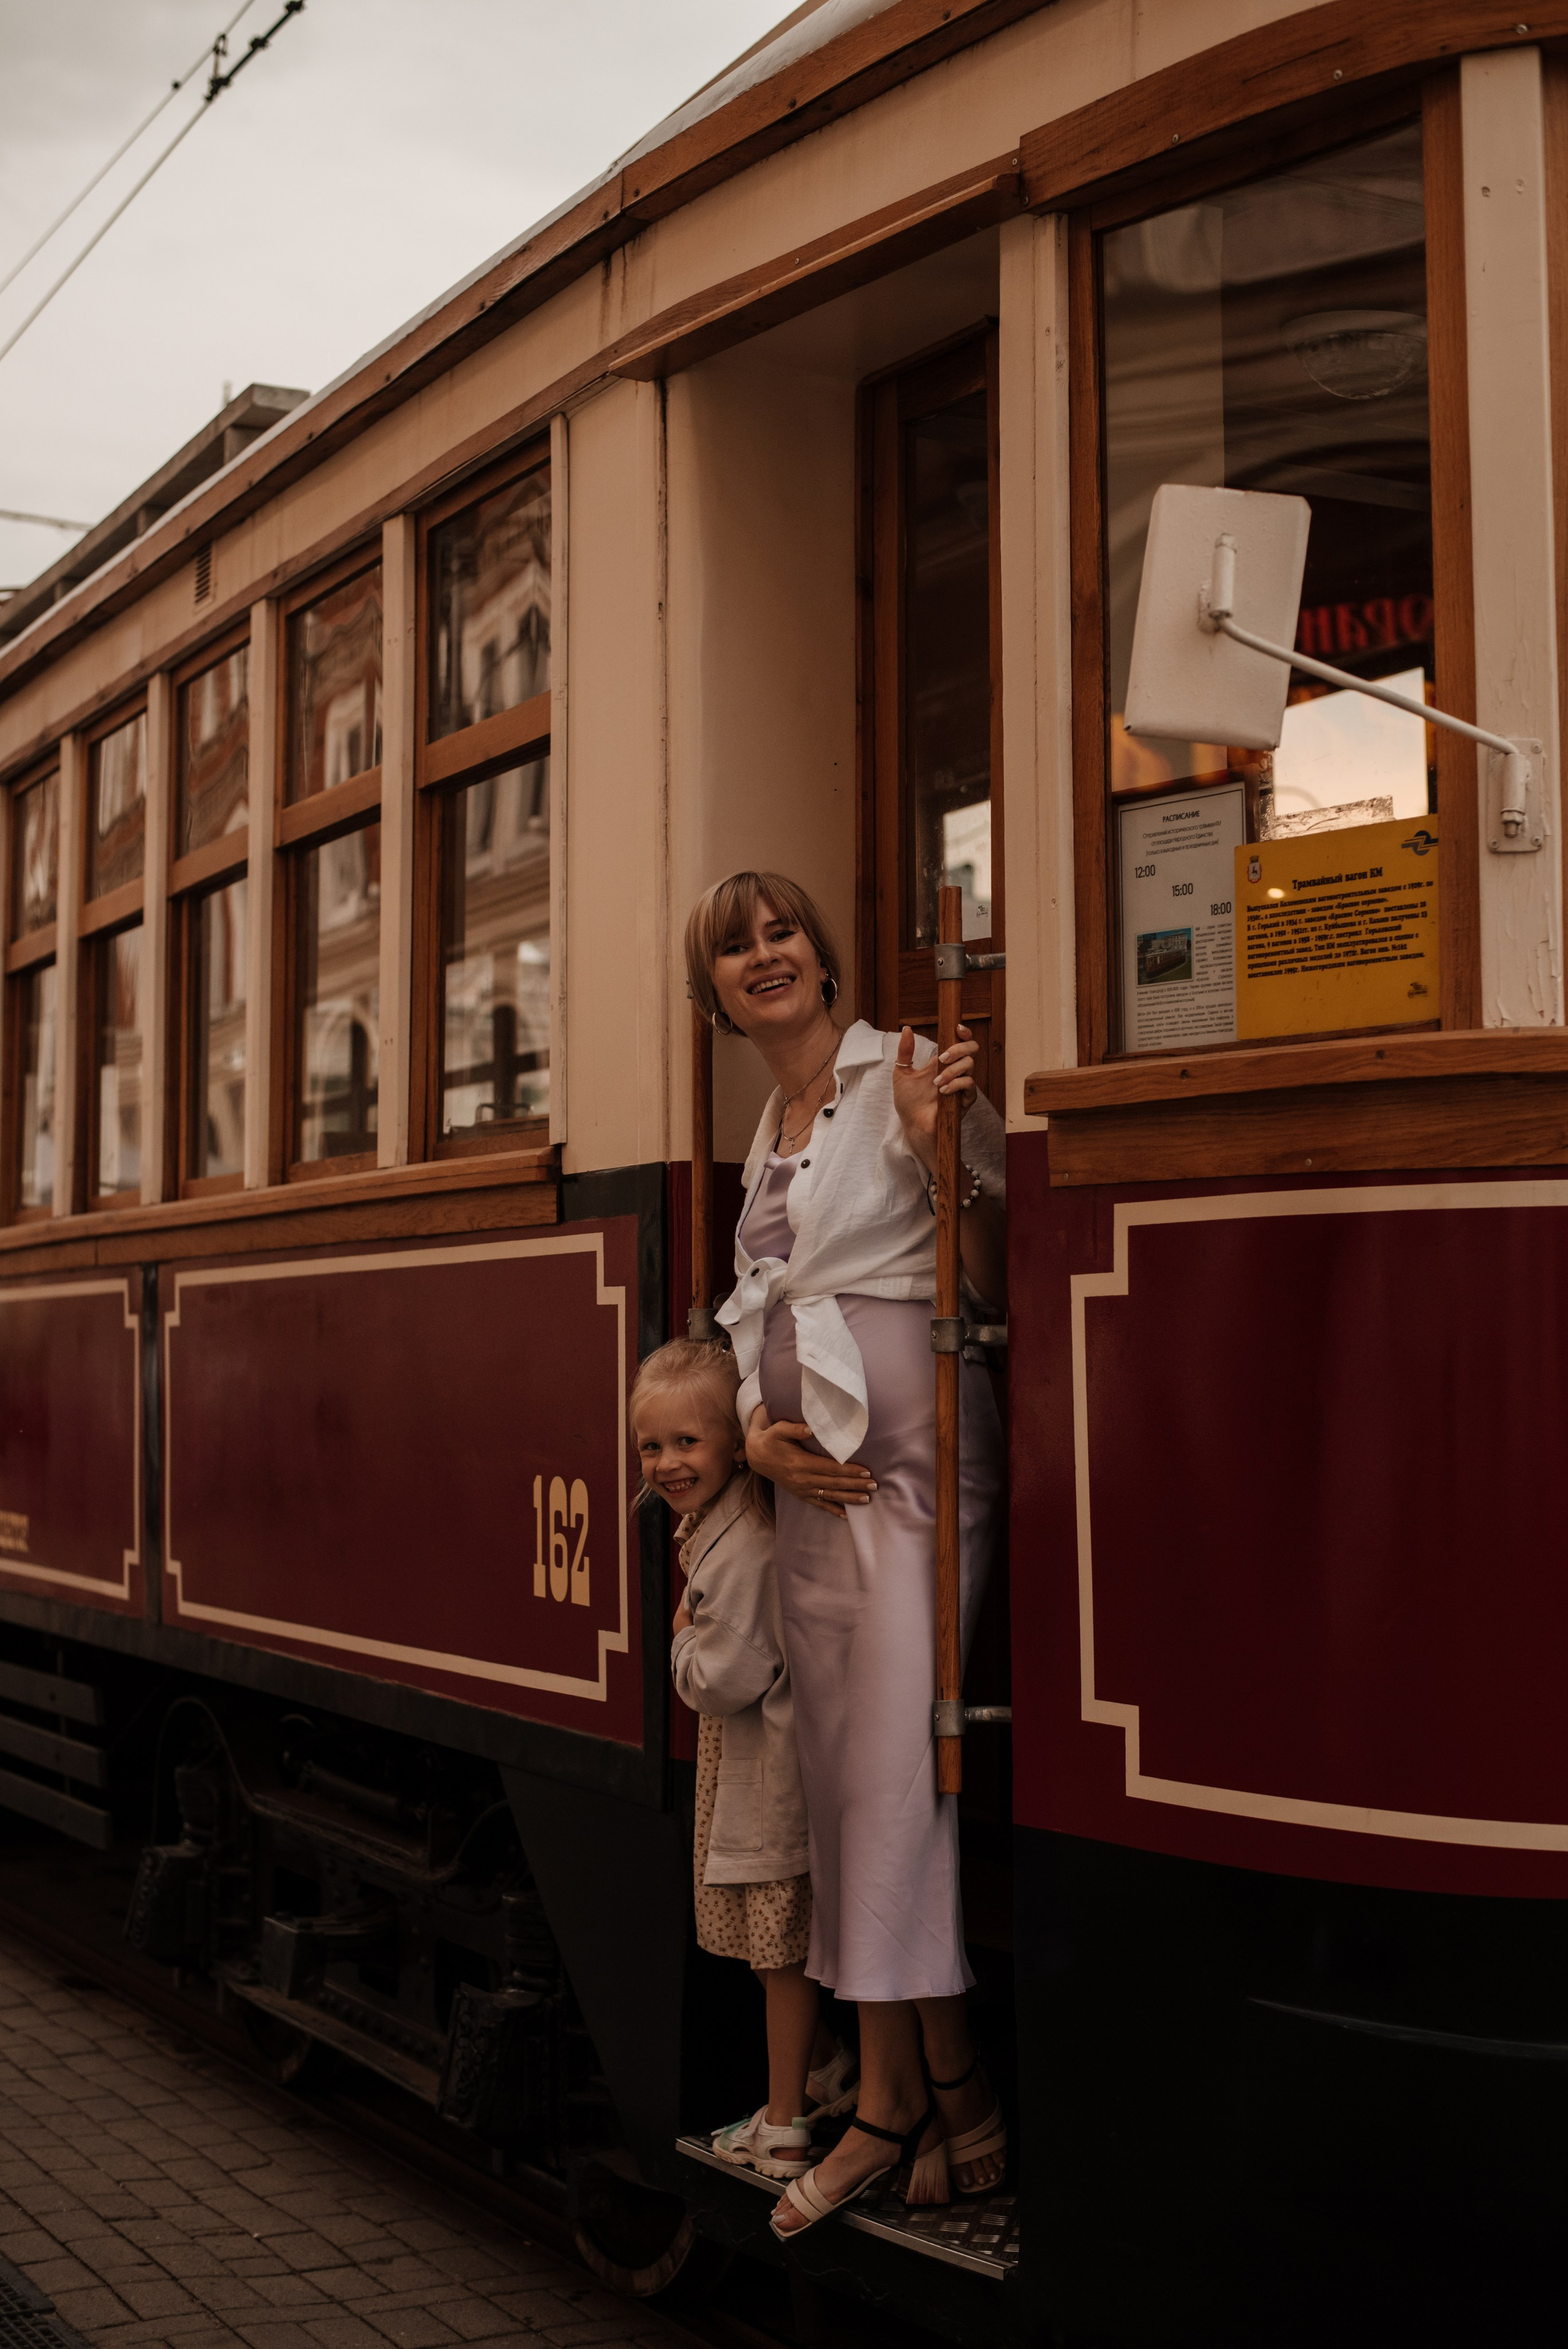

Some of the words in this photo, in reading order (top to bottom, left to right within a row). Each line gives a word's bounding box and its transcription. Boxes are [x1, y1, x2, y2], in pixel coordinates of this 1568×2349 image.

[1163, 810, 1200, 823] РАСПИСАНИЕ
[1135, 864, 1156, 878] 12:00
[1292, 873, 1343, 891] Трамвайный
[1344, 871, 1368, 881] вагон
[1369, 866, 1383, 878] КМ
[1172, 883, 1194, 897] 15:00
[1210, 902, 1232, 916] 18:00
[533, 1475, 590, 1607] 162
